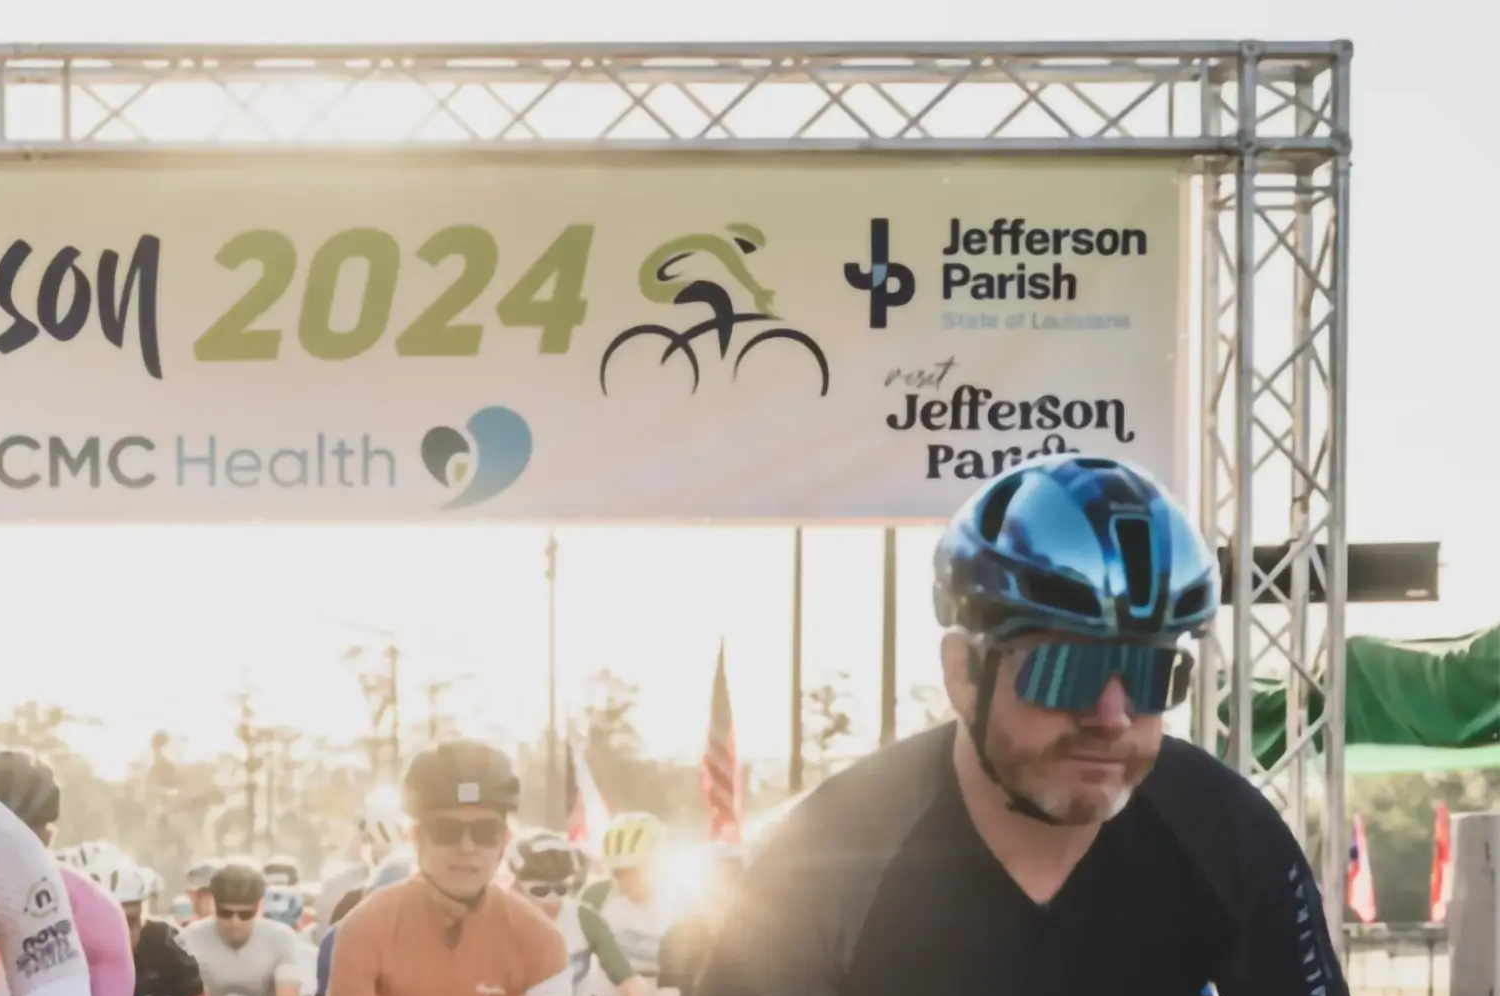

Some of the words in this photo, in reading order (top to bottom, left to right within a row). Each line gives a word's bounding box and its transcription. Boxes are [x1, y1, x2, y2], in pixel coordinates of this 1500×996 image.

[942, 218, 1148, 256] Jefferson
[196, 225, 594, 360] 2024
[942, 262, 1078, 301] Parish
[943, 312, 998, 329] State
[1005, 312, 1025, 329] of
[886, 384, 1135, 442] Jefferson
[175, 431, 396, 488] Health
